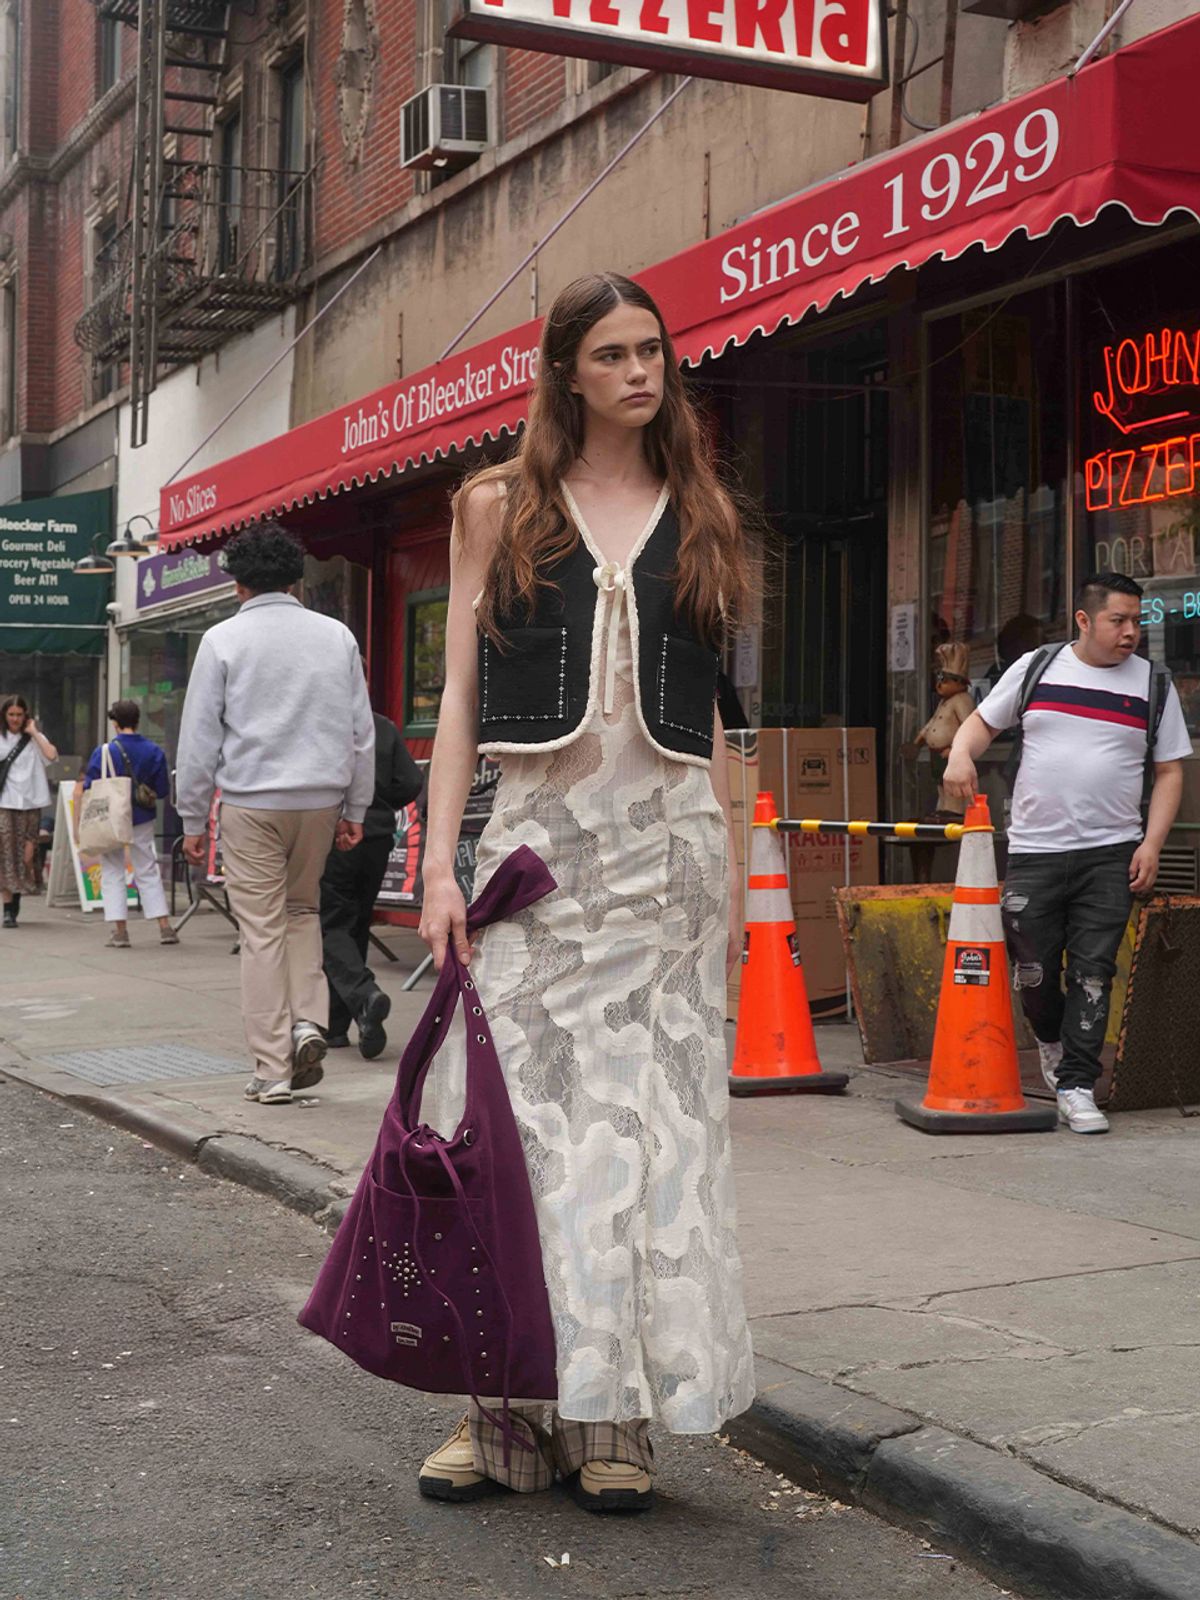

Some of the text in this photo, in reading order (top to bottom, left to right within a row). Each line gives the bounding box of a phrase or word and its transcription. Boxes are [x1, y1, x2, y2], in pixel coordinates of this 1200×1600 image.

[720, 108, 1060, 303] Since 1929
[341, 400, 389, 453] John's
[393, 386, 416, 432] Of
[417, 362, 496, 424] Bleecker
[169, 484, 217, 526] No Slices
[47, 519, 78, 533] Farm
[2, 539, 66, 552] Gourmet Deli
[14, 574, 58, 586] Beer ATM
[9, 594, 69, 606] OPEN 24 HOUR
